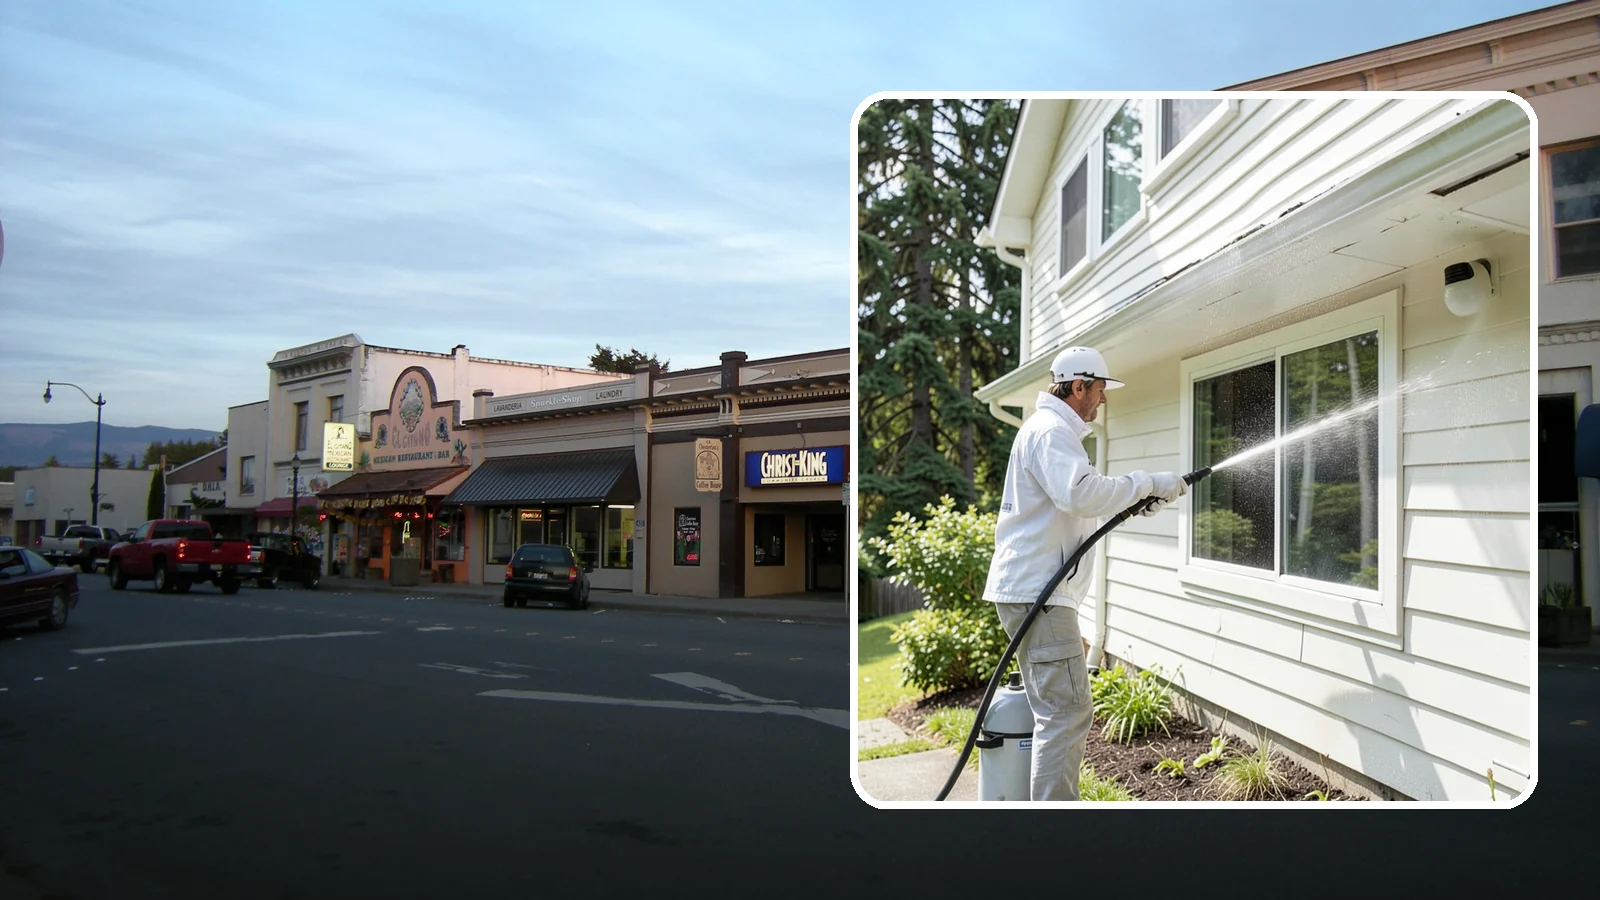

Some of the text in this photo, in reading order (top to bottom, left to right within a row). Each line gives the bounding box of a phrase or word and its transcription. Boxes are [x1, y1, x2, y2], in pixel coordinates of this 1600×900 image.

[493, 402, 522, 412] LAVANDERIA
[595, 389, 623, 399] LAUNDRY
[373, 455, 396, 463] MEXICAN
[397, 451, 433, 462] RESTAURANT
[437, 450, 450, 459] BAR
[761, 450, 827, 478] CHRIST KING
